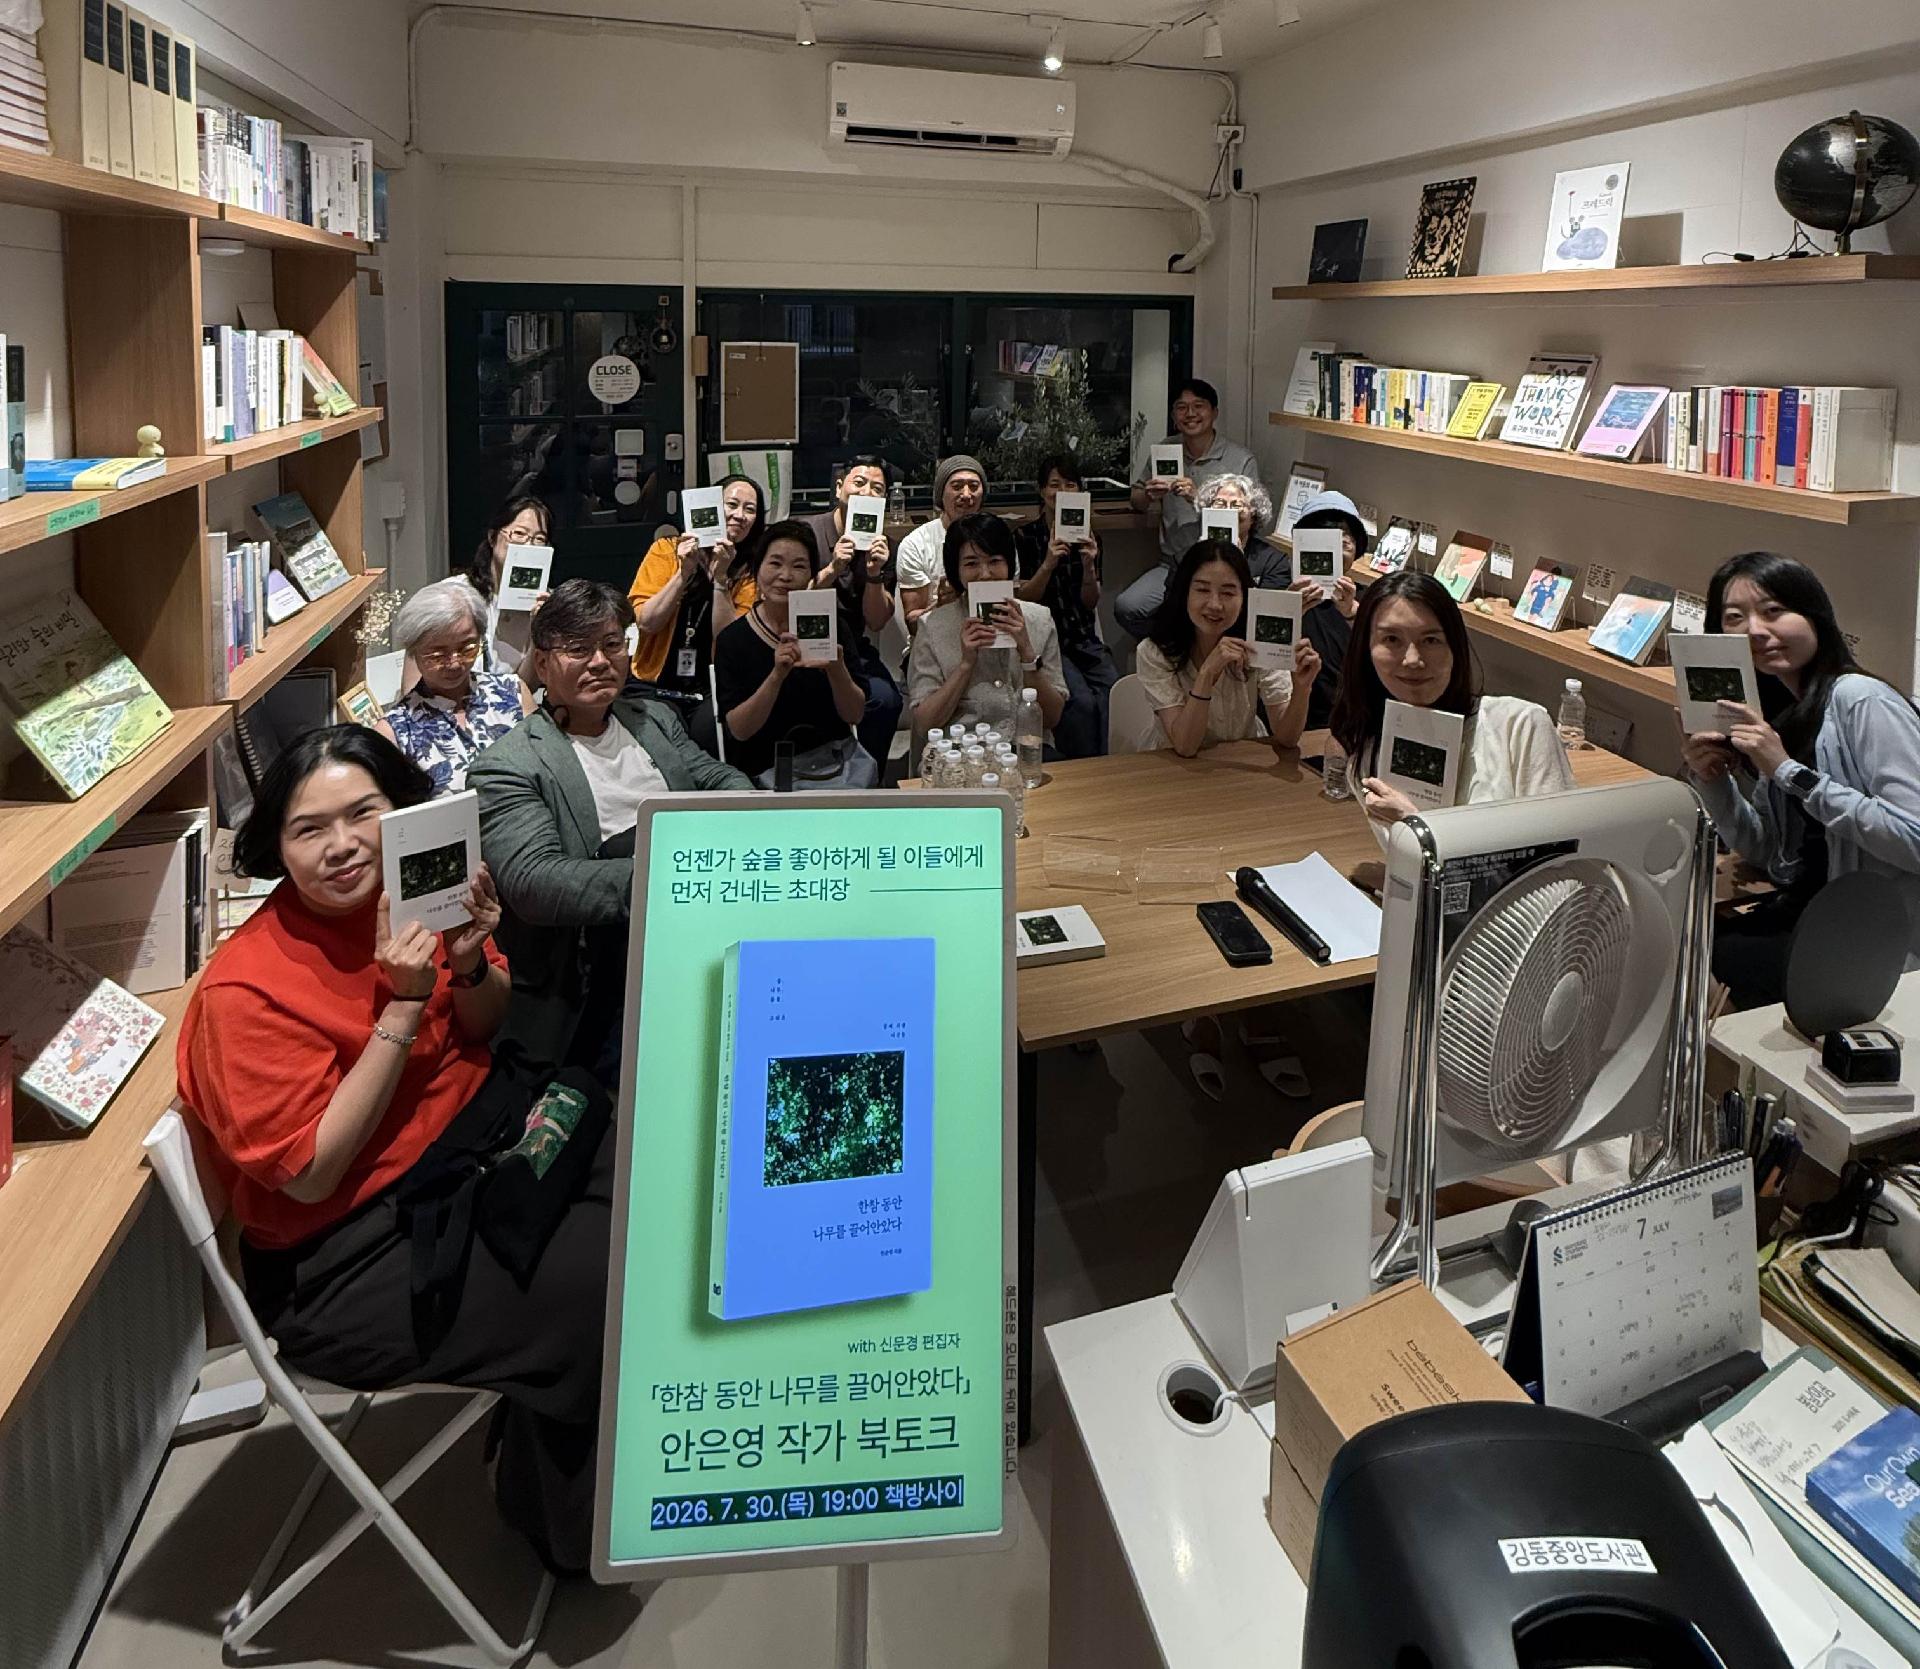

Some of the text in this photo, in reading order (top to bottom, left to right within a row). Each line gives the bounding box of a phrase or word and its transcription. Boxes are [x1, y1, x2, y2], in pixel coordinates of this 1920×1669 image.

[596, 364, 632, 376] CLOSE
[1520, 385, 1580, 408] THINGS
[1514, 405, 1570, 428] WORK
[30, 623, 55, 649] 숲의
[54, 610, 80, 631] 비밀
[673, 844, 983, 873] 언젠가 숲을 좋아하게 될 이들에게
[671, 877, 850, 904] 먼저 건네는 초대장
[858, 1194, 903, 1214] 한참 동안
[813, 1216, 903, 1242] 나무를 끌어안았다
[1637, 1218, 1647, 1240] 7
[1653, 1220, 1670, 1235] JULY
[848, 1332, 960, 1353] with 신문경 편집자
[715, 1378, 762, 1410] 동안
[770, 1374, 839, 1406] 나무를
[1005, 1285, 1017, 1480] 헤드폰은 모니터 뒤에 있습니다.
[661, 1416, 959, 1473] 안은영 작가 북토크
[1863, 1465, 1896, 1493] Our
[652, 1500, 713, 1526] 2026.
[721, 1497, 739, 1521] 7.
[822, 1487, 878, 1513] 19:00
[884, 1478, 964, 1507] 책방사이
[1506, 1540, 1648, 1567] 강동중앙도서관
